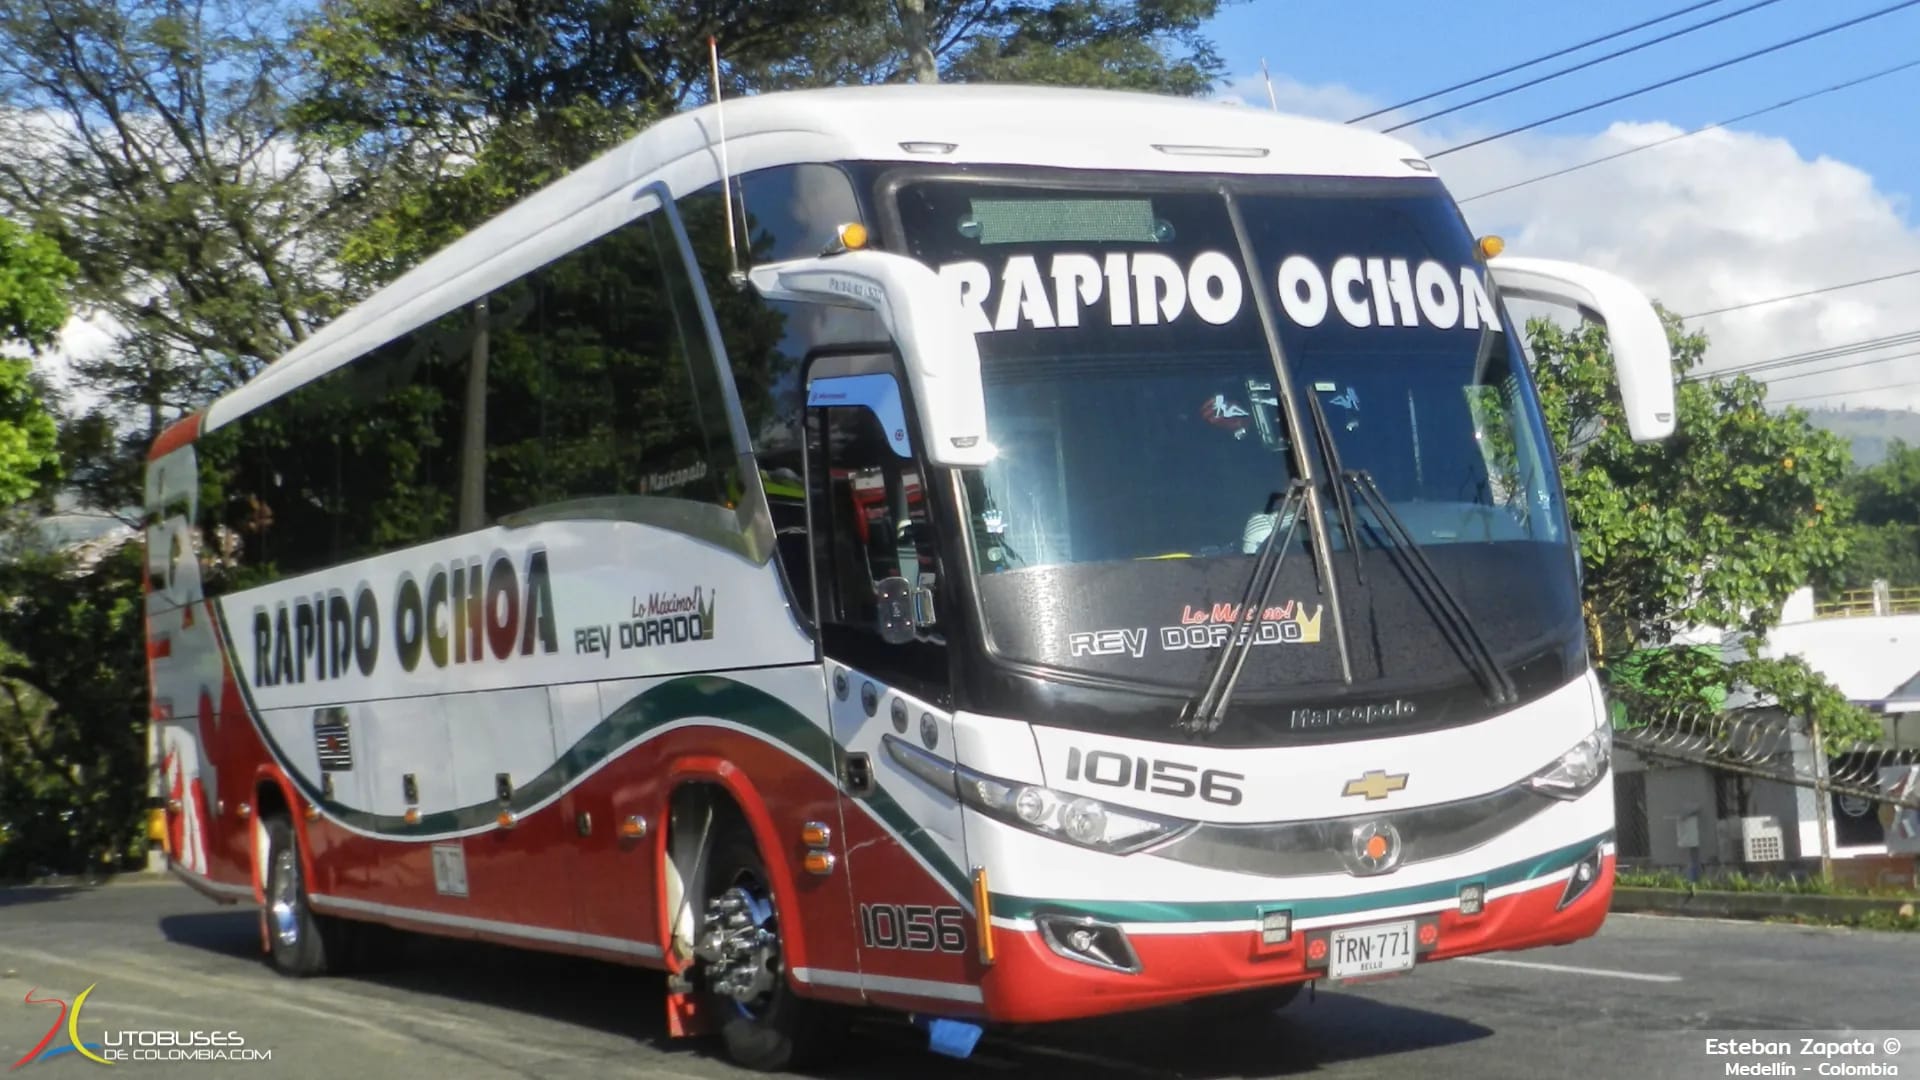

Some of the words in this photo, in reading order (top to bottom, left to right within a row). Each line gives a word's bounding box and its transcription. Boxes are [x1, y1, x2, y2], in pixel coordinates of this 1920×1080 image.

[939, 251, 1243, 333] RAPIDO
[1278, 256, 1503, 332] OCHOA
[253, 583, 380, 687] RAPIDO
[394, 546, 558, 672] OCHOA
[632, 596, 647, 618] Lo
[1182, 605, 1209, 624] Lo
[574, 623, 611, 659] REY
[618, 613, 703, 650] DORADO
[1069, 628, 1147, 658] REY
[1290, 699, 1416, 729] Marcopolo
[1066, 746, 1245, 806] 10156
[860, 902, 967, 953] 10156
[1360, 962, 1383, 971] BELLO
